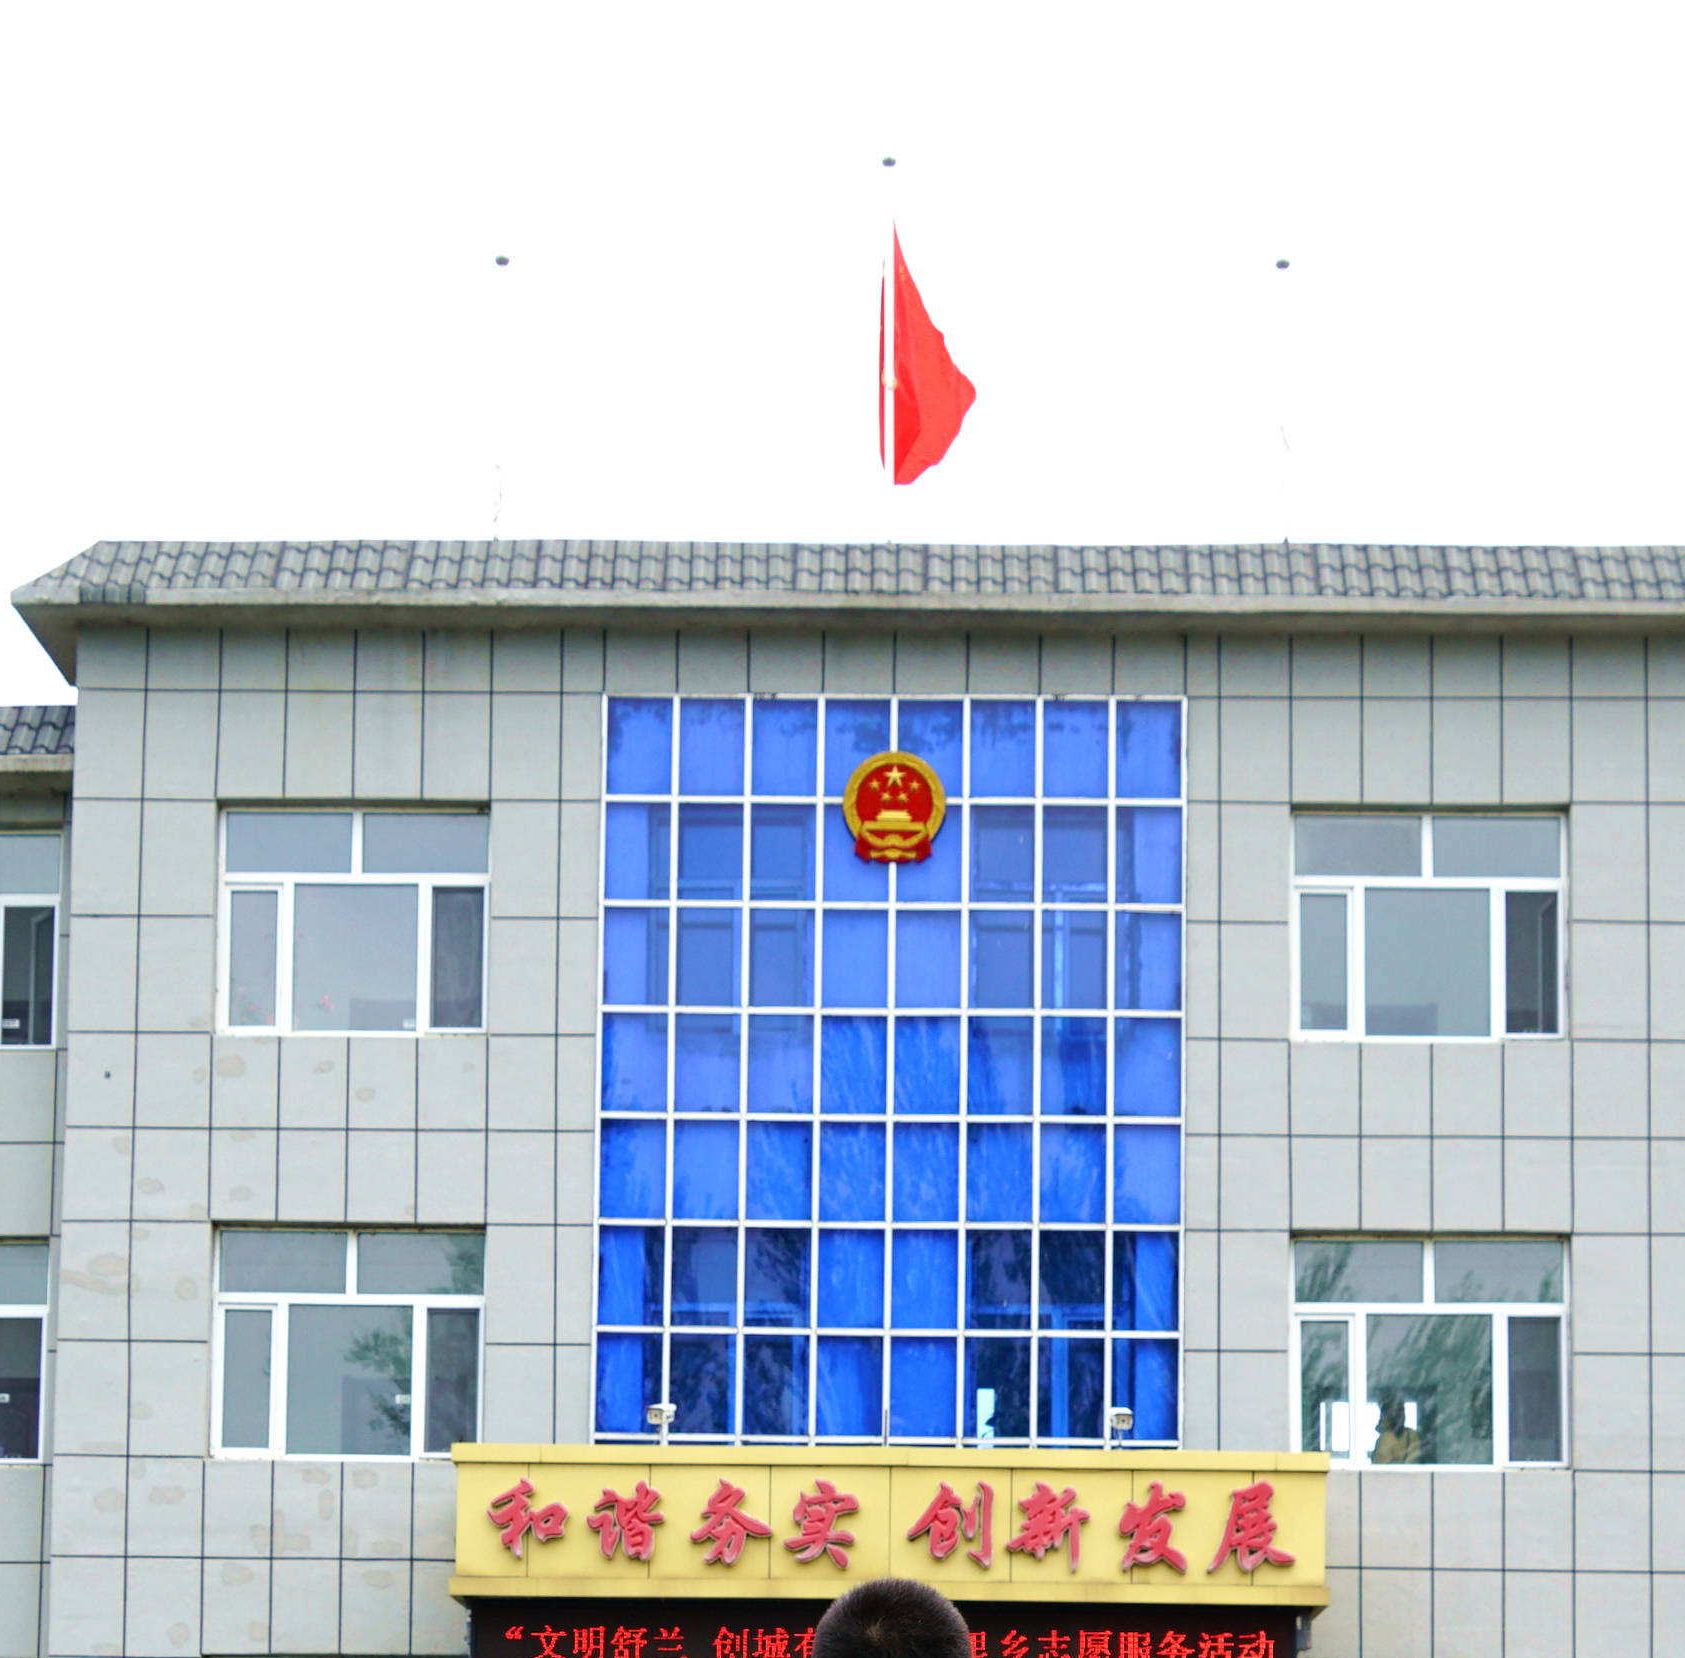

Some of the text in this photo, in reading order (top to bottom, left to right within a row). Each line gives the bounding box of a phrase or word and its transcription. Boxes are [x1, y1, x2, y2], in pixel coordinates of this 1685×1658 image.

[487, 1477, 1296, 1574] 和谐务实 创新发展
